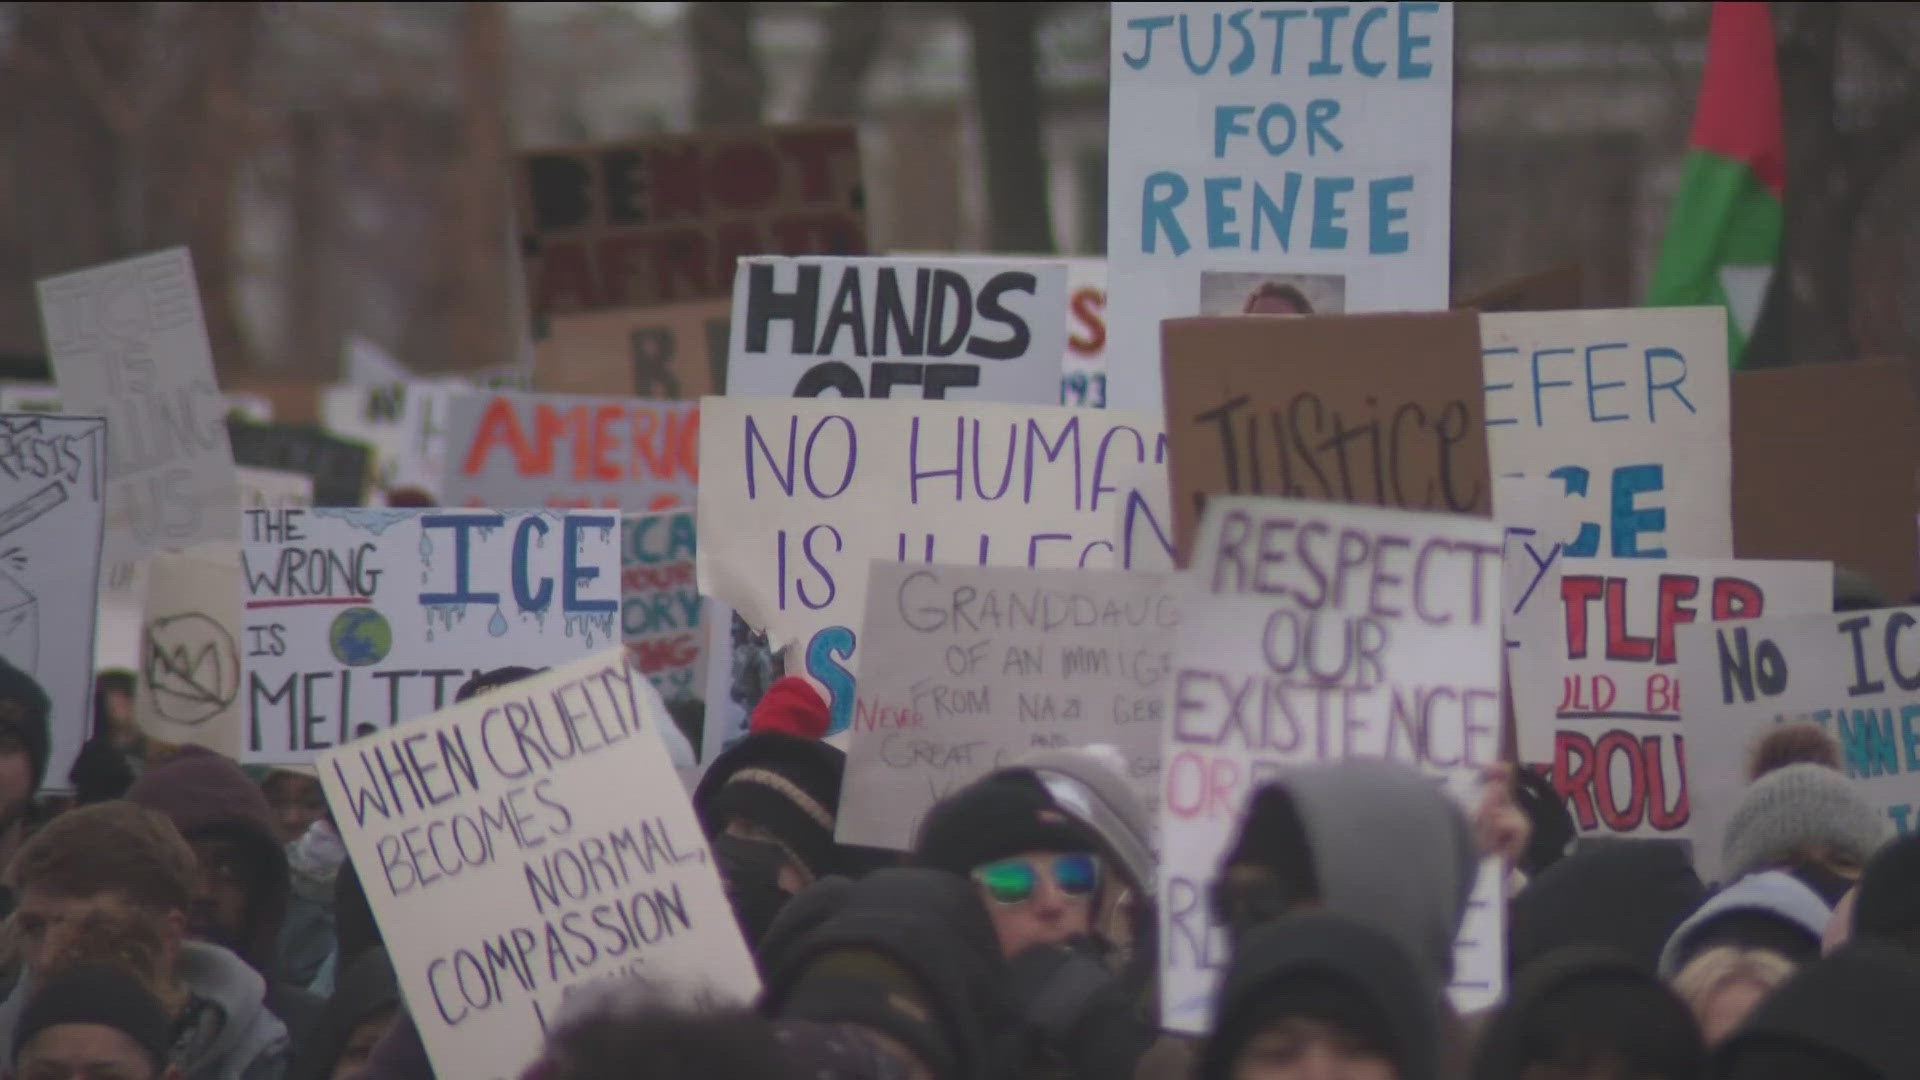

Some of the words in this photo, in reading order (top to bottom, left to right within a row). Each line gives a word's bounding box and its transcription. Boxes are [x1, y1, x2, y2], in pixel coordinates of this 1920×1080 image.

[1122, 3, 1440, 80] JUSTICE
[1214, 99, 1344, 158] FOR
[1141, 171, 1415, 256] RENEE
[744, 264, 1037, 360] HANDS
[745, 415, 858, 499] NO
[245, 509, 306, 543] THE
[419, 515, 619, 612] ICE
[777, 524, 842, 610] IS
[1212, 510, 1502, 626] RESPECT
[240, 543, 383, 597] WRONG
[246, 624, 286, 656] IS
[946, 640, 992, 676] OF
[1002, 645, 1045, 676] AN
[1262, 607, 1387, 686] OUR
[247, 667, 483, 752] MELTI
[909, 678, 993, 720] FROM
[1173, 669, 1498, 769] EXISTENCE
[332, 724, 479, 828] WHEN
[481, 659, 641, 779] CRUELTY
[1167, 752, 1240, 818] OR
[376, 778, 572, 898] BECOMES
[523, 816, 707, 913] NORMAL,
[427, 883, 692, 1026] COMPASSION
